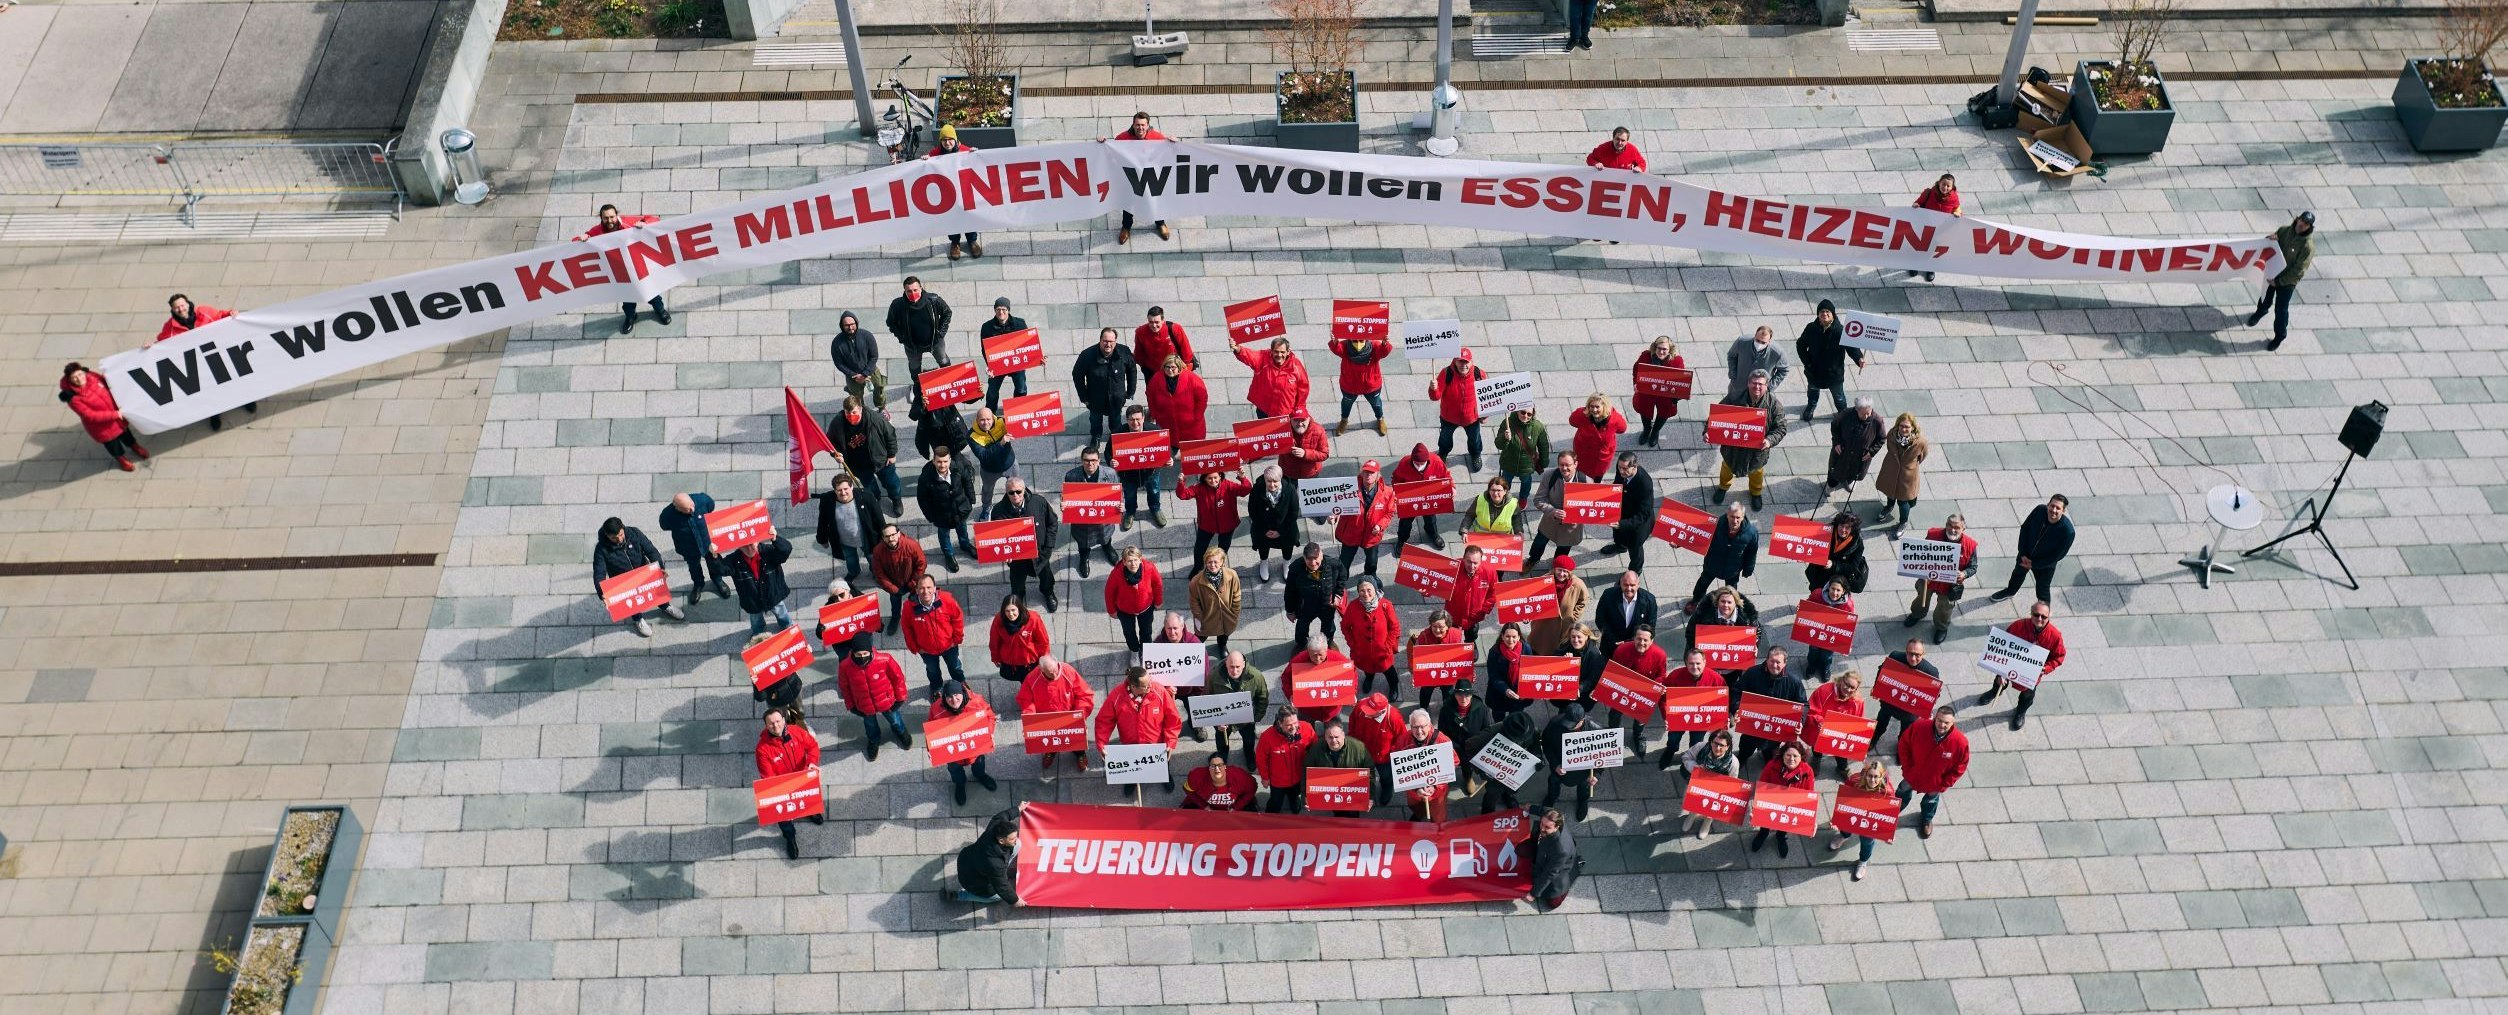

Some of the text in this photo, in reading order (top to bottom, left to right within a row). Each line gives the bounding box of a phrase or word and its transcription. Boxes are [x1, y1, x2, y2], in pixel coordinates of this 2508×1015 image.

[128, 341, 255, 406] Wir
[272, 282, 505, 360] wollen
[515, 223, 718, 301] KEINE
[734, 157, 1110, 248] MILLIONEN,
[1123, 155, 1219, 198] wir
[1234, 163, 1443, 202] wollen
[1460, 176, 1687, 233] ESSEN,
[1704, 190, 1949, 259] HEIZEN,
[1230, 313, 1280, 328] TEUERUNG STOPPEN!
[1335, 316, 1389, 325] TEUERUNG STOPPEN!
[1405, 329, 1460, 345] Heizöl +45%
[989, 344, 1039, 360] TEUERUNG STOPPEN!
[925, 377, 977, 395] TEUERUNG STOPPEN!
[1476, 380, 1514, 395] 300 Euro
[1478, 382, 1531, 402] Winterbonus
[1480, 398, 1503, 411] jetzt!
[1007, 408, 1060, 422] TEUERUNG STOPPEN!
[1711, 420, 1763, 433] TEUERUNG STOPPEN!
[1116, 445, 1168, 456] TEUERUNG STOPPEN!
[1301, 483, 1354, 496] Teuerungs-
[1303, 496, 1332, 506] 100er
[1567, 499, 1620, 509] TEUERUNG STOPPEN!
[1660, 515, 1711, 539] TEUERUNG STOPPEN!
[979, 534, 1034, 547] TEUERUNG STOPPEN!
[1774, 532, 1829, 548] TEUERUNG STOPPEN!
[1903, 543, 1955, 551] Pensions-
[1496, 548, 1521, 557] STOPPEN!
[1903, 553, 1954, 563] erhöhung
[1401, 561, 1456, 583] TEUERUNG STOPPEN!
[1500, 593, 1555, 606] TEUERUNG STOPPEN!
[853, 609, 878, 621] STOPPEN!
[1798, 618, 1855, 637] TEUERUNG STOPPEN!
[1728, 644, 1756, 653] STOPPEN!
[1989, 635, 2029, 654] 300 Euro
[1144, 655, 1202, 670] Brot +6%
[1983, 652, 2009, 665] jetzt!
[1987, 643, 2044, 667] Winterbonus
[1416, 660, 1472, 670] TEUERUNG STOPPEN!
[1295, 679, 1353, 689] TEUERUNG STOPPEN!
[1522, 673, 1578, 682] TEUERUNG STOPPEN!
[1881, 675, 1935, 702] TEUERUNG STOPPEN!
[1192, 700, 1251, 716] Strom +12%
[1669, 705, 1727, 713] TEUERUNG STOPPEN!
[1741, 710, 1798, 727] TEUERUNG STOPPEN!
[930, 727, 988, 747] TEUERUNG STOPPEN!
[1027, 727, 1084, 738] TEUERUNG STOPPEN!
[1564, 731, 1618, 746] Pensions-
[1822, 728, 1870, 744] TEUERUNG STOPPEN!
[1491, 738, 1530, 760] Energie-
[1565, 739, 1617, 755] erhöhung
[1107, 754, 1165, 770] Gas +41%
[1393, 748, 1438, 766] Energie-
[1485, 747, 1522, 769] steuern
[1567, 747, 1622, 764] vorziehen!
[1396, 757, 1438, 775] steuern
[1479, 755, 1518, 776] senken!
[1398, 765, 1441, 784] senken!
[1309, 785, 1367, 794] TEUERUNG STOPPEN!
[1690, 786, 1747, 807] TEUERUNG STOPPEN!
[1756, 800, 1815, 817] TEUERUNG STOPPEN!
[1838, 804, 1896, 824] TEUERUNG STOPPEN!
[1493, 815, 1519, 829] SPÖ
[1036, 838, 1396, 879] TEUERUNG STOPPEN!
